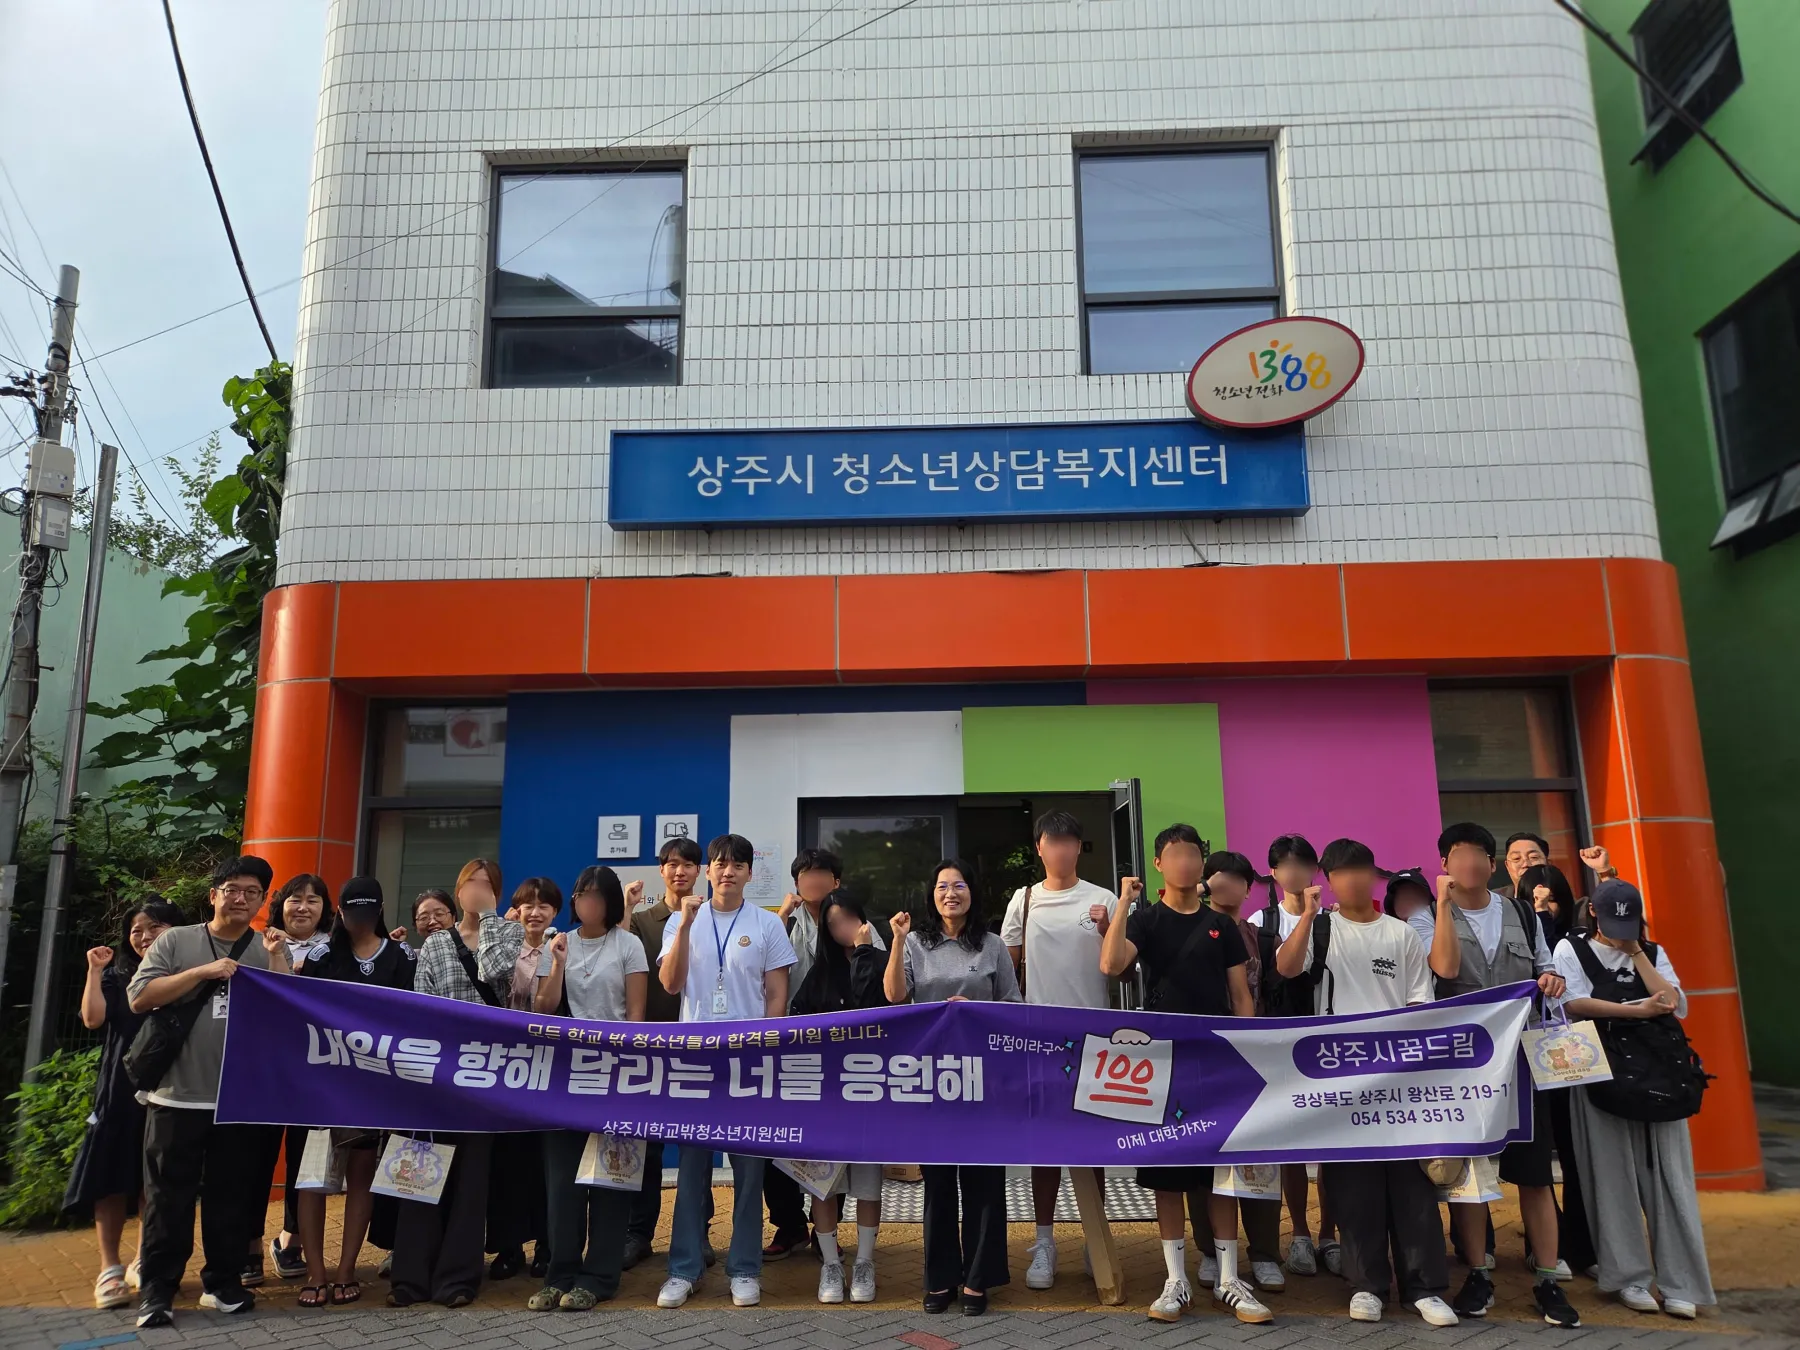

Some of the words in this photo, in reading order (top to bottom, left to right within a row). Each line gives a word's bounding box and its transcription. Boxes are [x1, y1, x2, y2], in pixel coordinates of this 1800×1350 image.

[1248, 347, 1332, 392] 1388
[687, 453, 815, 498] 상주시
[832, 445, 1228, 494] 청소년상담복지센터
[527, 1023, 562, 1040] 모든
[567, 1027, 602, 1045] 학교
[608, 1032, 627, 1048] 밖
[632, 1033, 721, 1050] 청소년들의
[727, 1030, 781, 1049] 합격을
[787, 1027, 822, 1045] 기원
[828, 1024, 888, 1042] 합니다.
[988, 1033, 1065, 1055] 만점이라구~
[1315, 1031, 1475, 1069] 상주시꿈드림
[306, 1023, 442, 1085] 내일을
[452, 1040, 556, 1092] 향해
[567, 1047, 715, 1100] 달리는
[728, 1053, 825, 1101] 너를
[839, 1052, 984, 1103] 응원해
[1095, 1049, 1154, 1085] 100
[1292, 1091, 1354, 1108] 경상북도
[1358, 1087, 1402, 1105] 상주시
[1407, 1085, 1456, 1103] 왕산로
[1351, 1111, 1381, 1126] 054
[1386, 1109, 1417, 1125] 534
[1422, 1108, 1465, 1123] 3513
[602, 1120, 803, 1144] 상주시학교밖청소년지원센터
[1116, 1132, 1147, 1149] 이제
